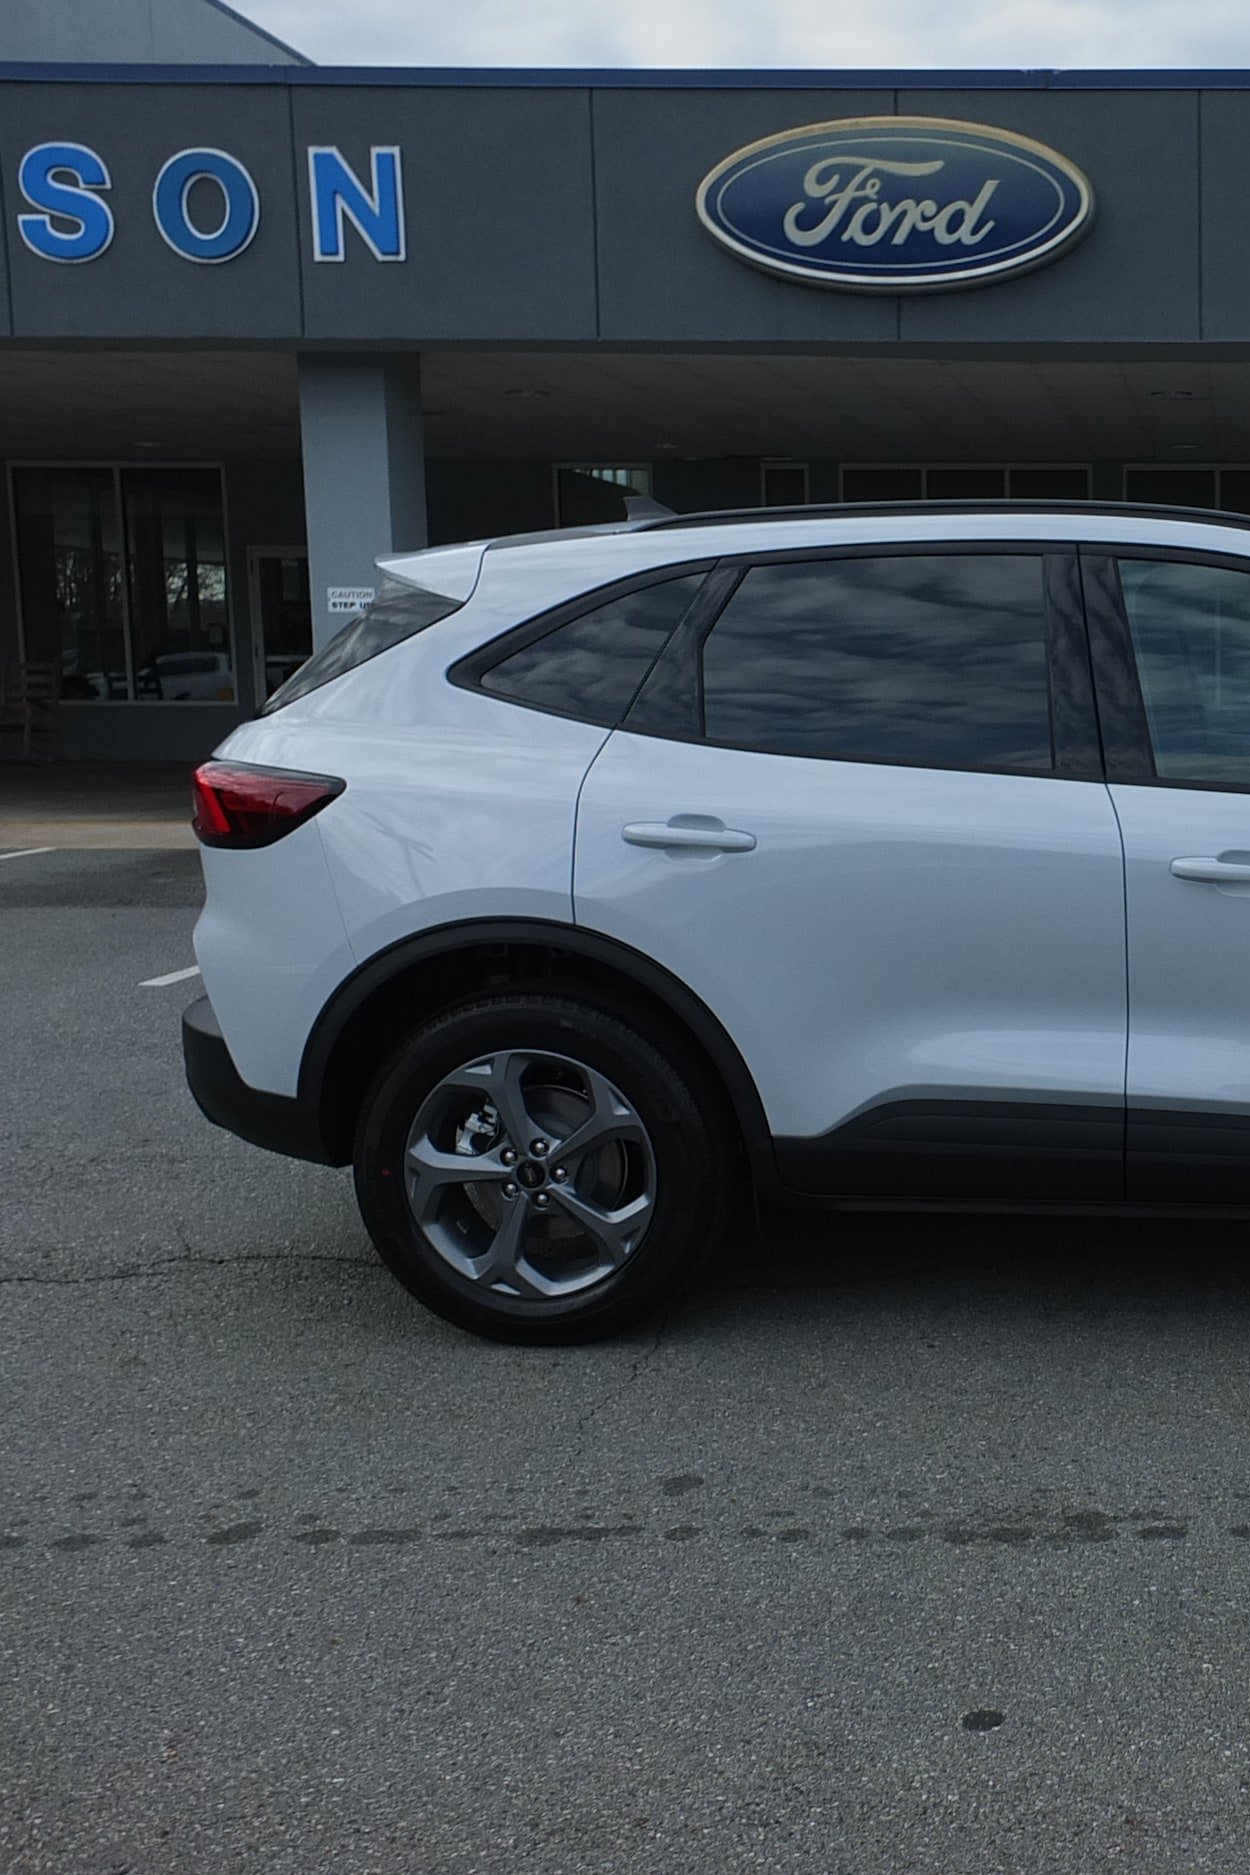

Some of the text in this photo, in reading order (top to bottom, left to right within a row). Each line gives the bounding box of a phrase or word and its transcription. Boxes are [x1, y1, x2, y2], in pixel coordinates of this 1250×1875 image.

[17, 142, 406, 264] SON
[783, 156, 999, 247] Ford
[331, 591, 373, 599] CAUTION
[332, 601, 356, 609] STEP
